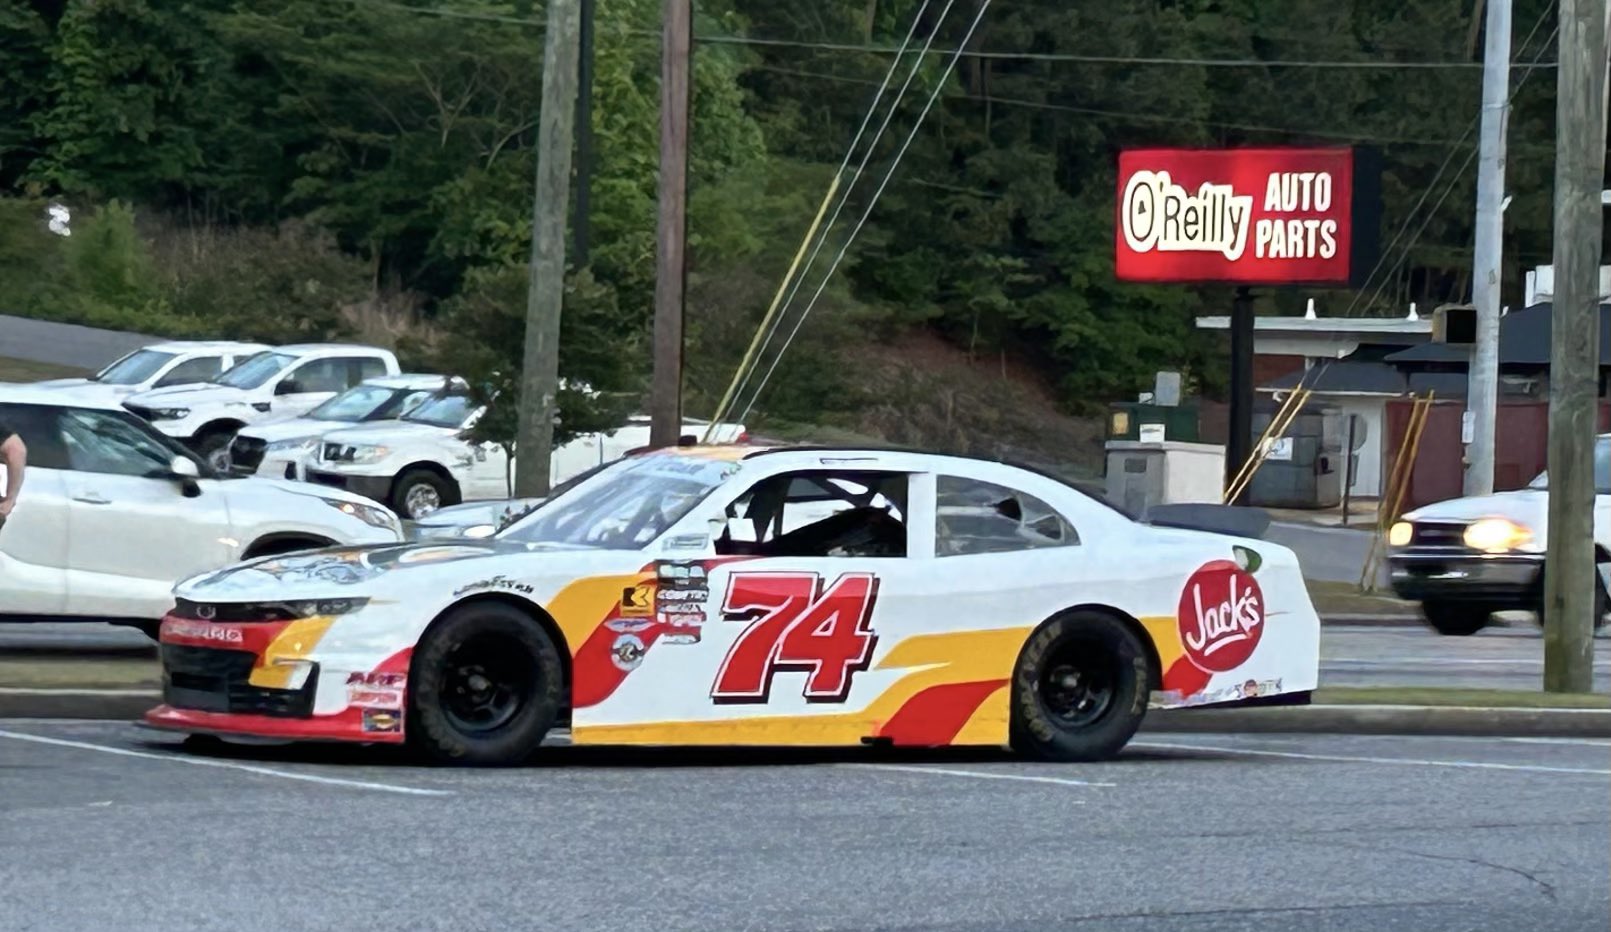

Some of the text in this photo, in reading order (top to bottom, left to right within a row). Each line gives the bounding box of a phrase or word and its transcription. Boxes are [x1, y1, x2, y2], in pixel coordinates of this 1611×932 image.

[1124, 172, 1251, 259] O'Reilly
[1264, 172, 1332, 212] AUTO
[1255, 219, 1337, 259] PARTS
[709, 572, 880, 704] 74
[1186, 574, 1260, 651] Jack's
